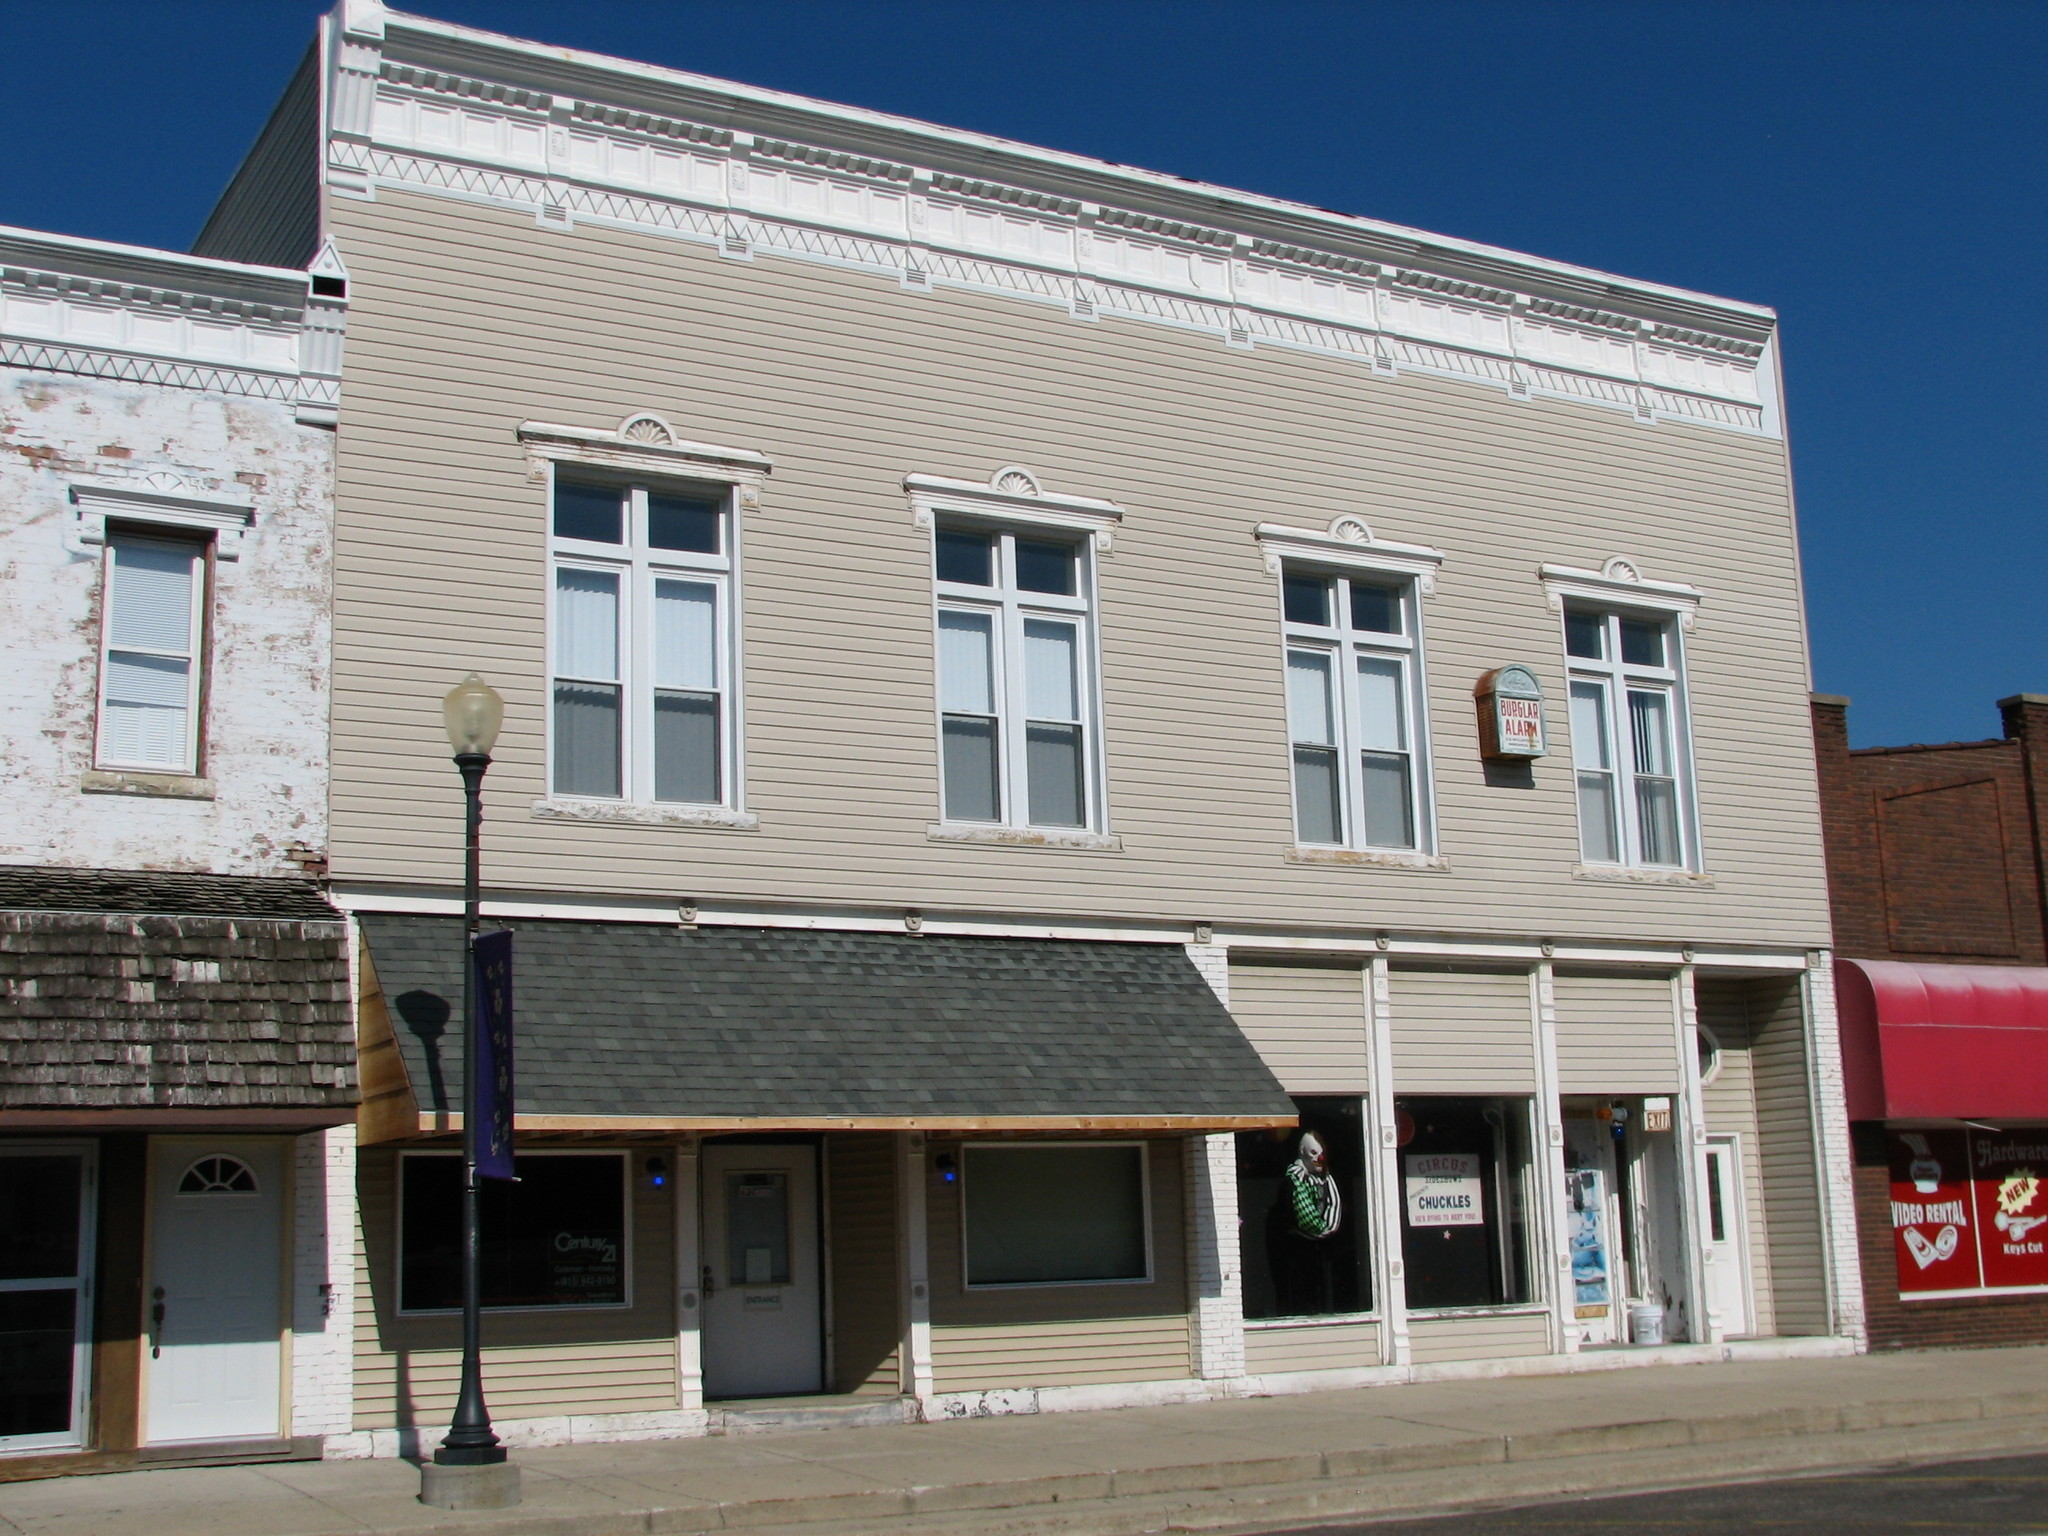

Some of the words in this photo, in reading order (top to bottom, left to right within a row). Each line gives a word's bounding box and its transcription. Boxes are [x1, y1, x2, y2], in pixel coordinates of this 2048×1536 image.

[1501, 700, 1539, 719] BURGLAR
[1505, 719, 1538, 737] ALARM
[1648, 1111, 1668, 1129] EXIT
[1976, 1139, 2048, 1167] Hardware
[1417, 1157, 1469, 1175] CIRCUS
[2005, 1177, 2030, 1204] NEW
[1418, 1195, 1471, 1210] CHUCKLES
[1890, 1200, 1924, 1228] VIDEO
[1926, 1199, 1967, 1227] RENTAL
[555, 1232, 607, 1252] Century
[2003, 1242, 2026, 1256] Keys
[2028, 1242, 2044, 1254] Cut
[601, 1244, 617, 1262] 21
[746, 1295, 780, 1304] ENTRANCE
